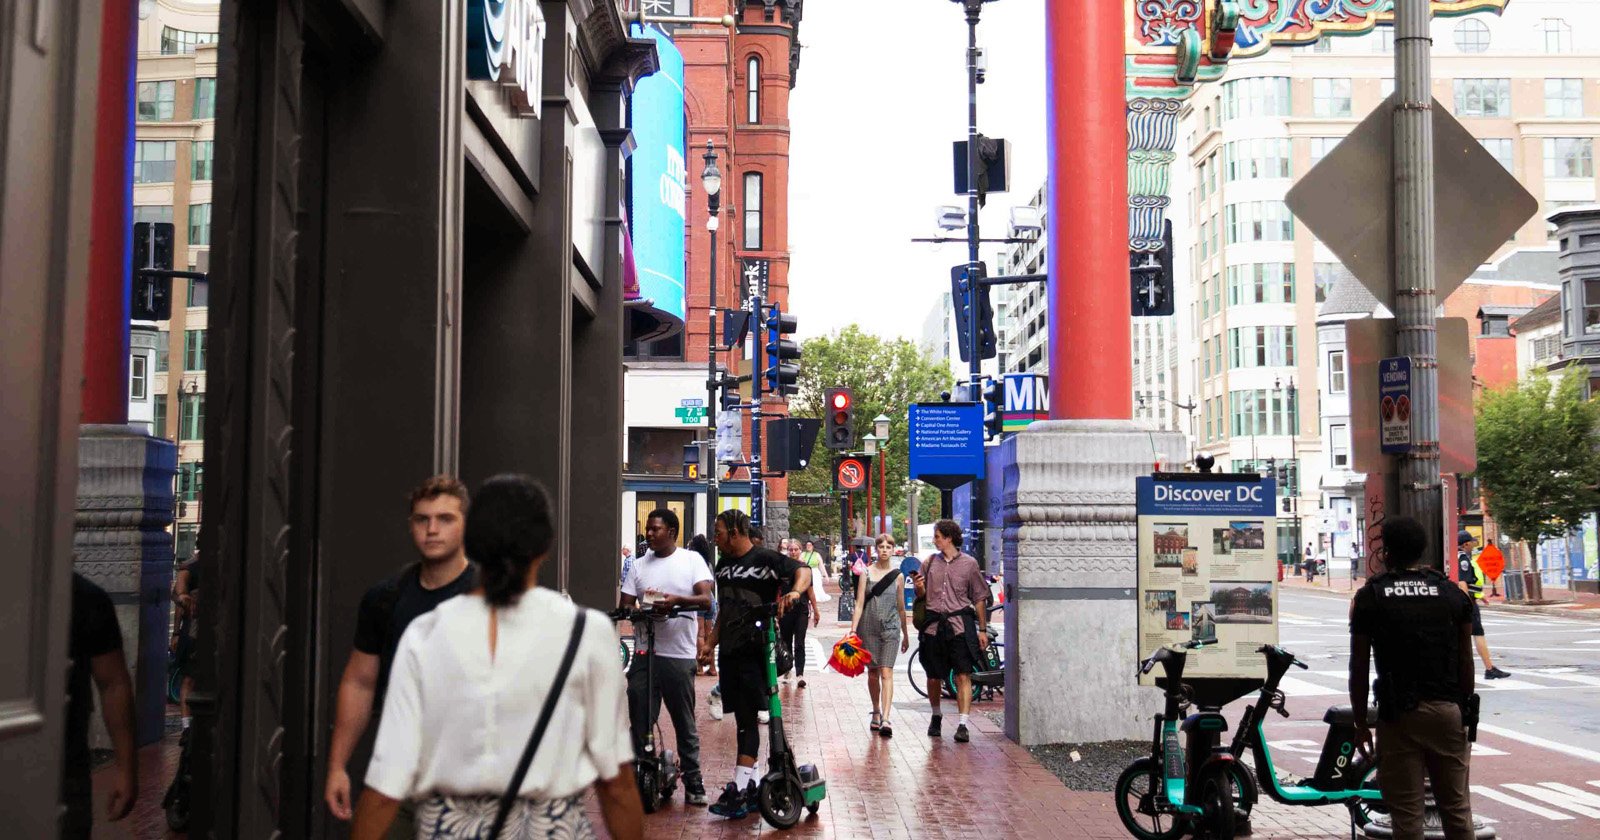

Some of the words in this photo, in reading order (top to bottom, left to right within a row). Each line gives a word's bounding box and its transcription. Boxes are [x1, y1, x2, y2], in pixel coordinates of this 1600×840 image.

[1383, 371, 1407, 382] VENDING
[1005, 377, 1032, 411] M
[686, 408, 693, 417] 7
[689, 464, 697, 479] 6
[1154, 484, 1231, 502] Discover
[1236, 485, 1263, 502] DC
[1384, 586, 1439, 597] POLICE
[1331, 741, 1352, 779] veo
